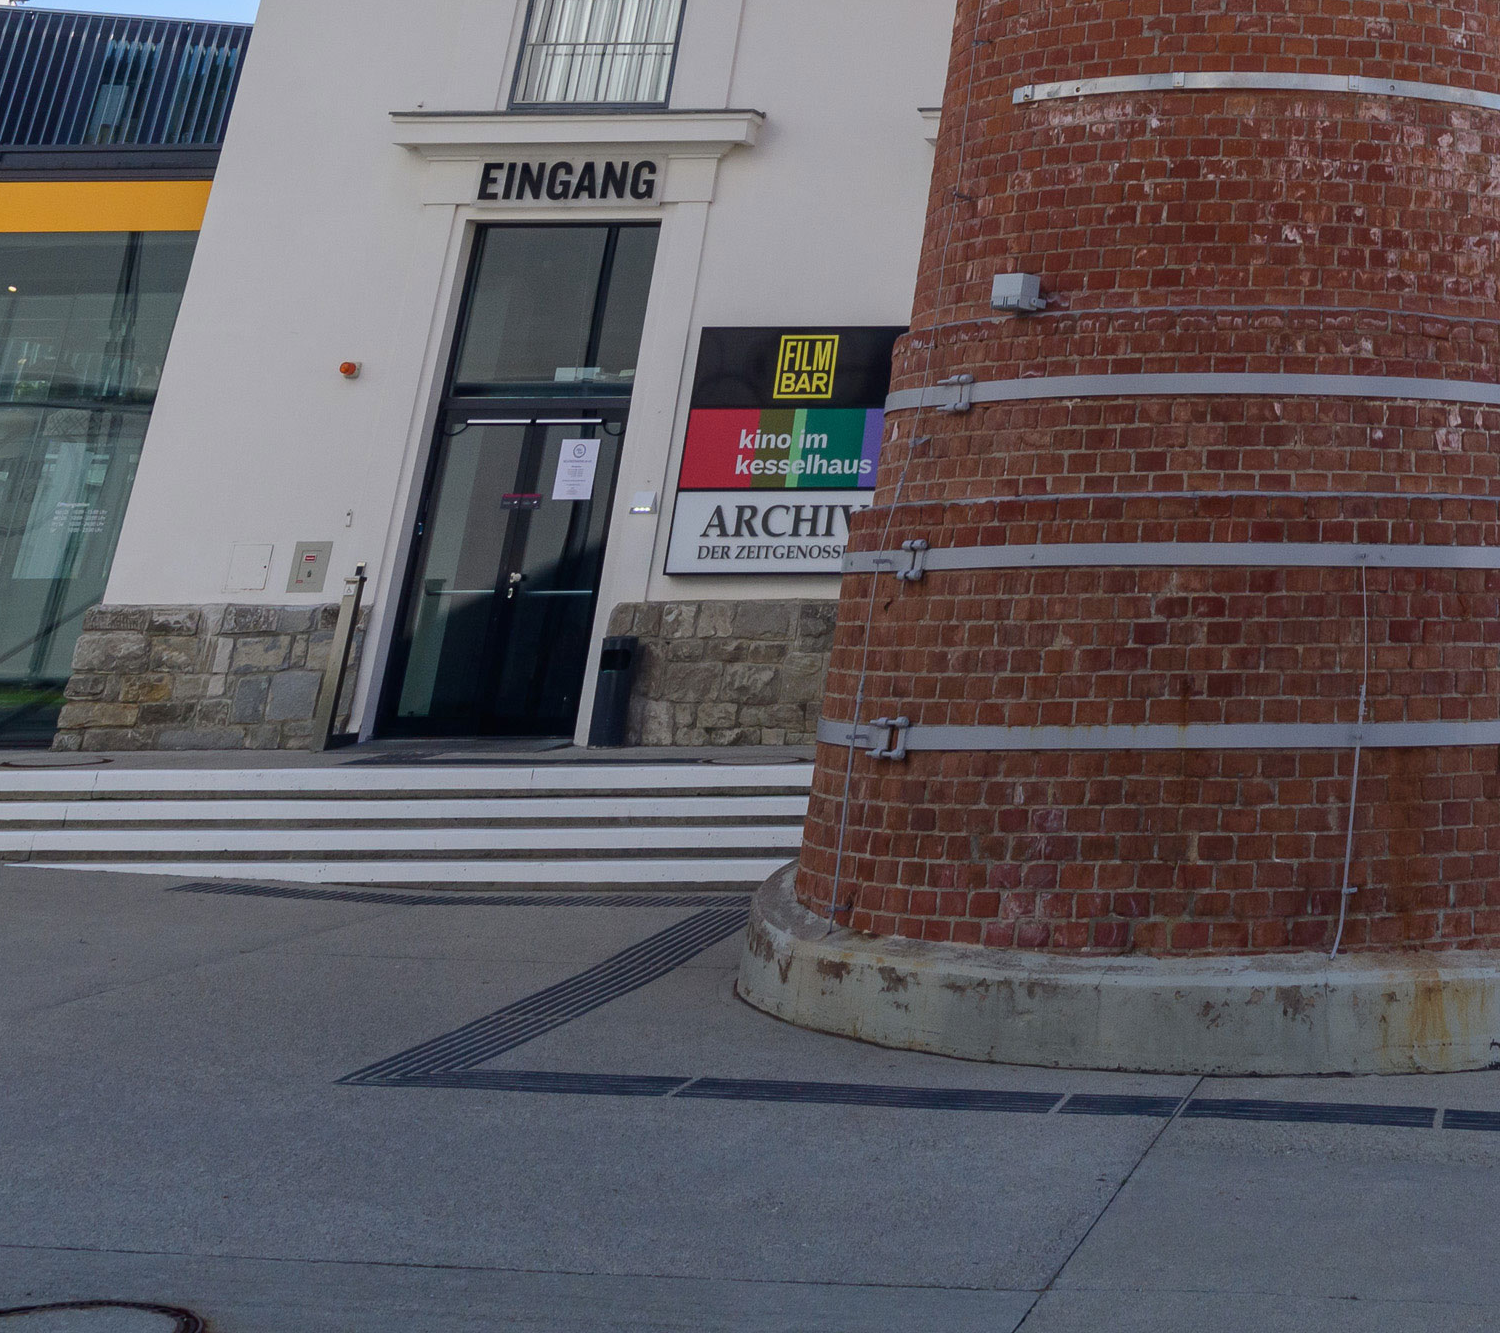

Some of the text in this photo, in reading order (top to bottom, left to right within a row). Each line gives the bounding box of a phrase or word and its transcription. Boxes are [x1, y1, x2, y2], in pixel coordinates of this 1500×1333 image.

[477, 160, 657, 201] EINGANG
[783, 341, 832, 371] FILM
[780, 372, 829, 393] BAR
[738, 428, 828, 449] kino im
[735, 454, 872, 475] kesselhaus
[697, 545, 731, 560] DER
